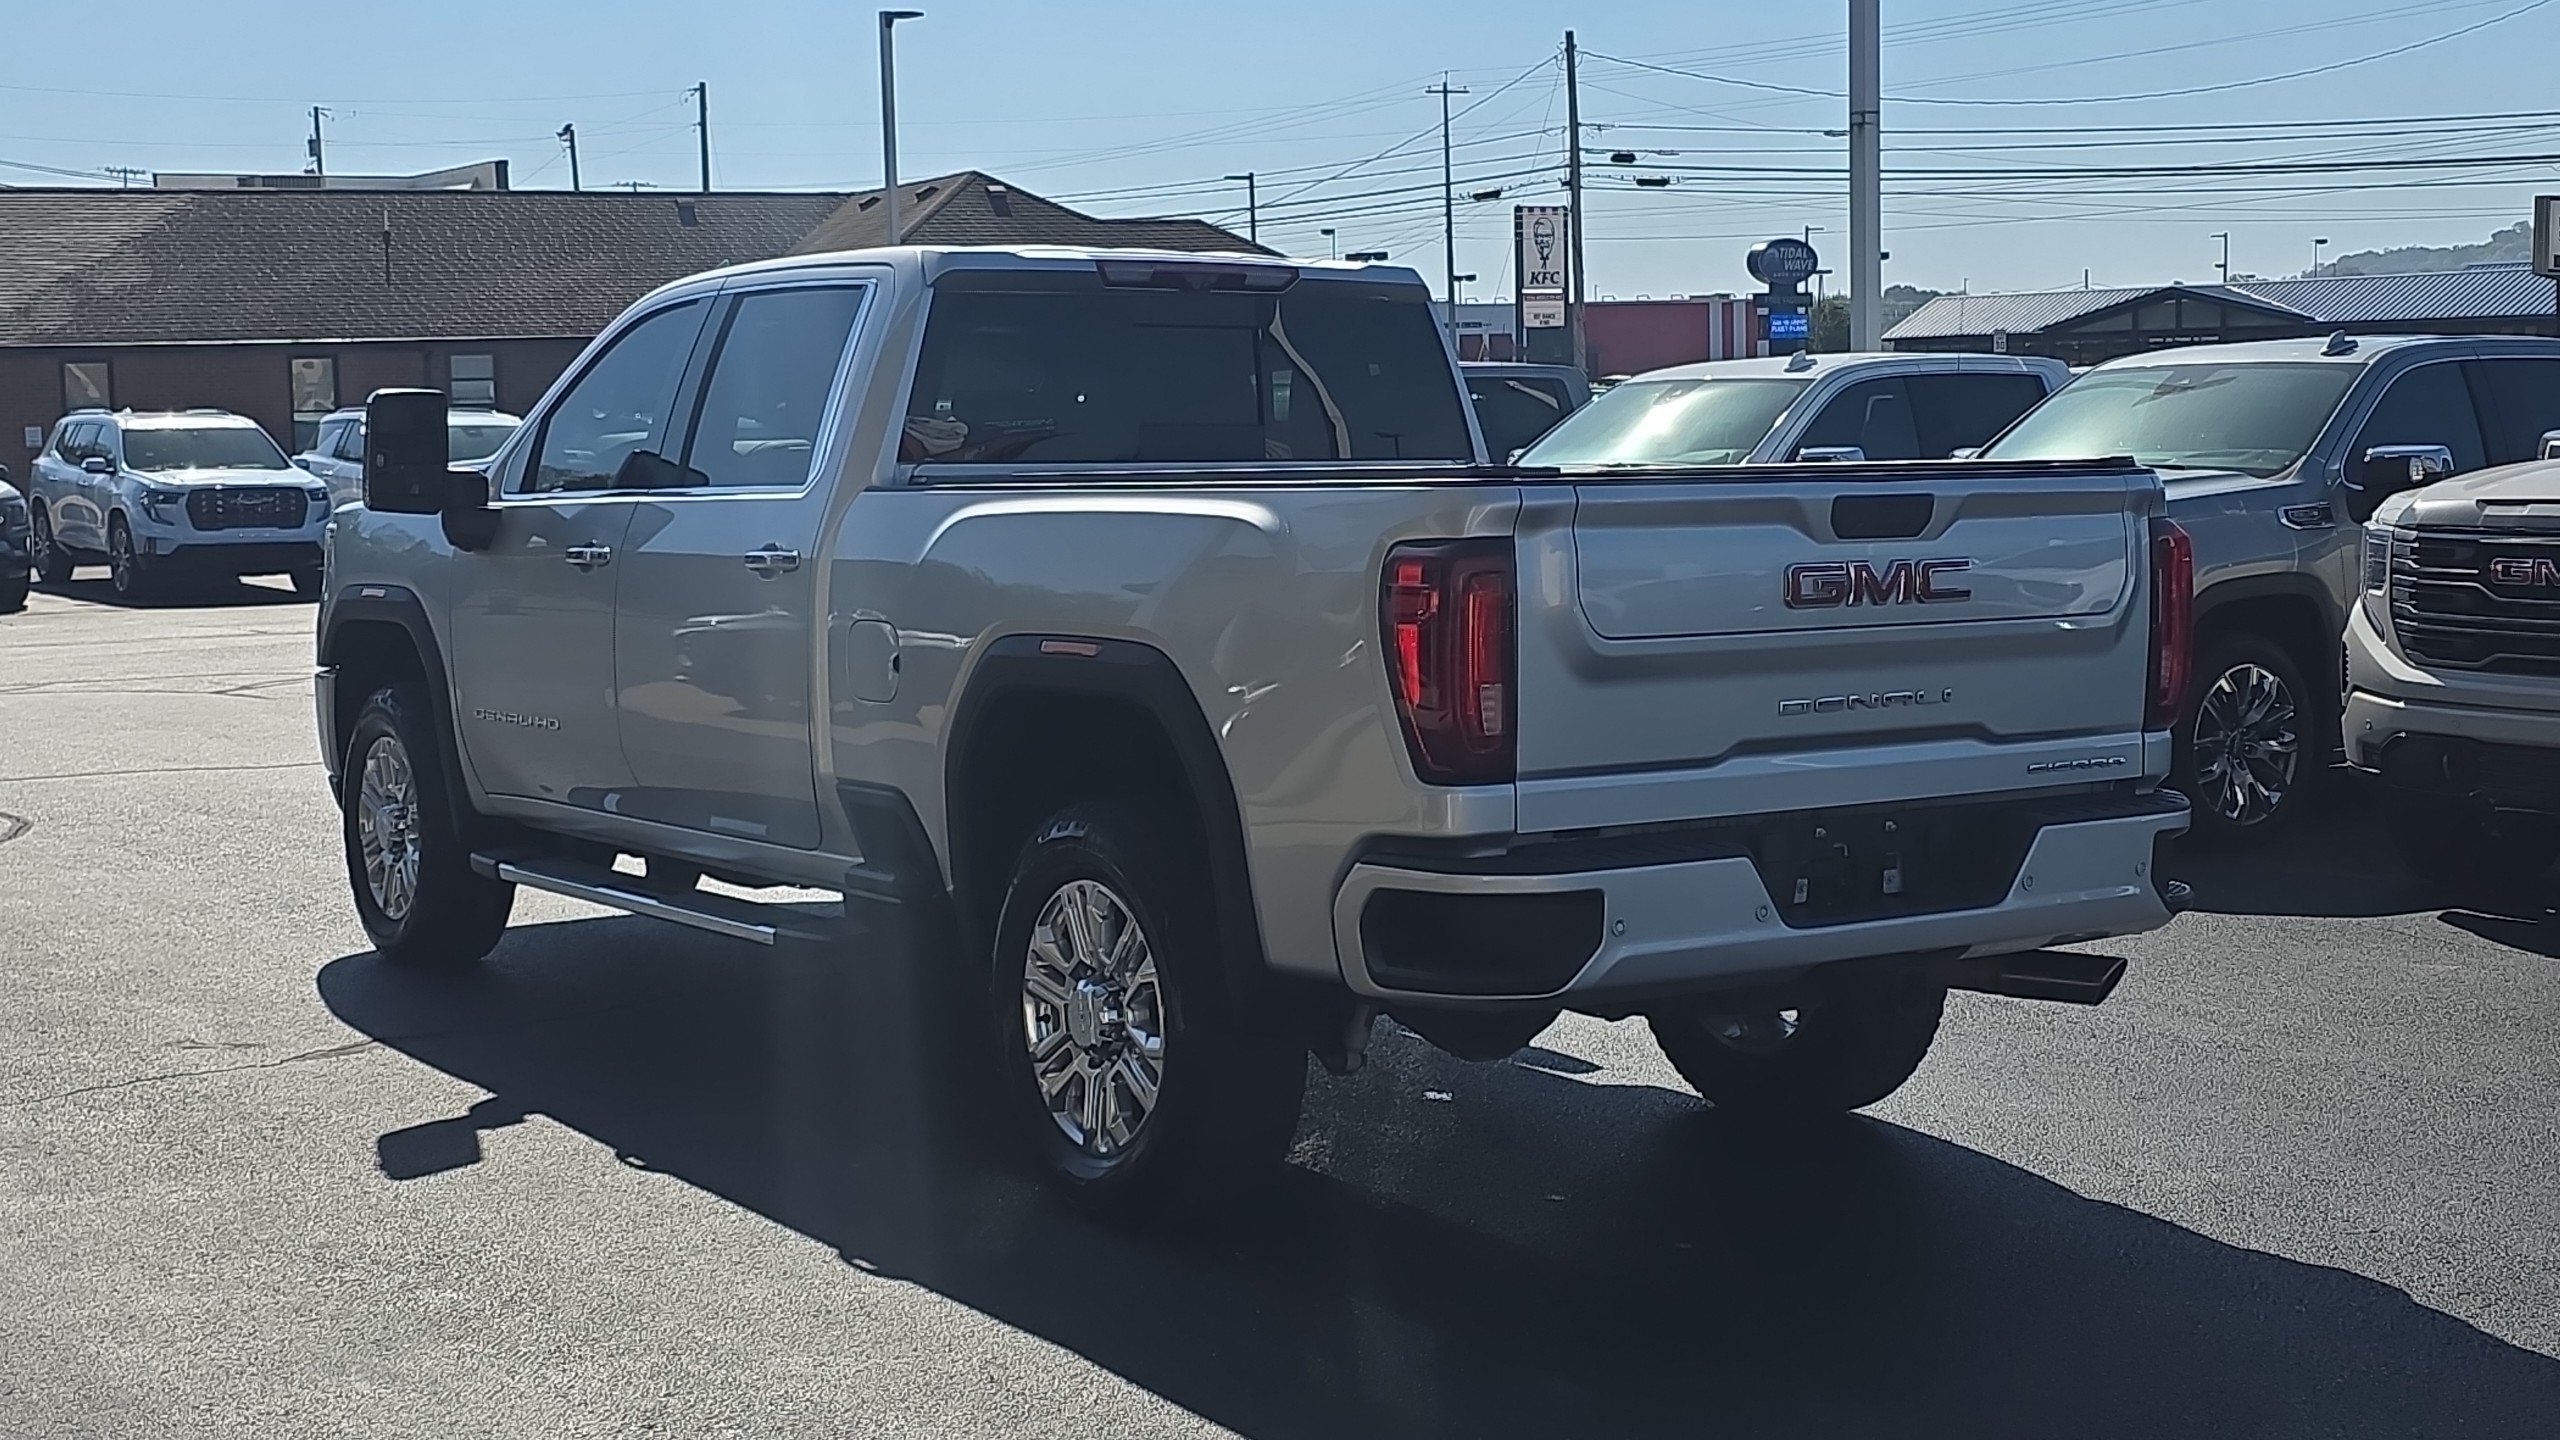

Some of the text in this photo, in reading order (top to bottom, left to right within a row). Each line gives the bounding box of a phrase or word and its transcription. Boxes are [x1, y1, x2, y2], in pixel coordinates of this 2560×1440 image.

[1780, 247, 1808, 259] TIDAL
[1784, 259, 1814, 271] WAVE
[1529, 270, 1560, 285] KFC
[1784, 558, 1972, 610] GMC
[1779, 688, 1952, 717] DENALI
[474, 708, 561, 731] DENALI HD
[2027, 756, 2126, 775] SIERRA
